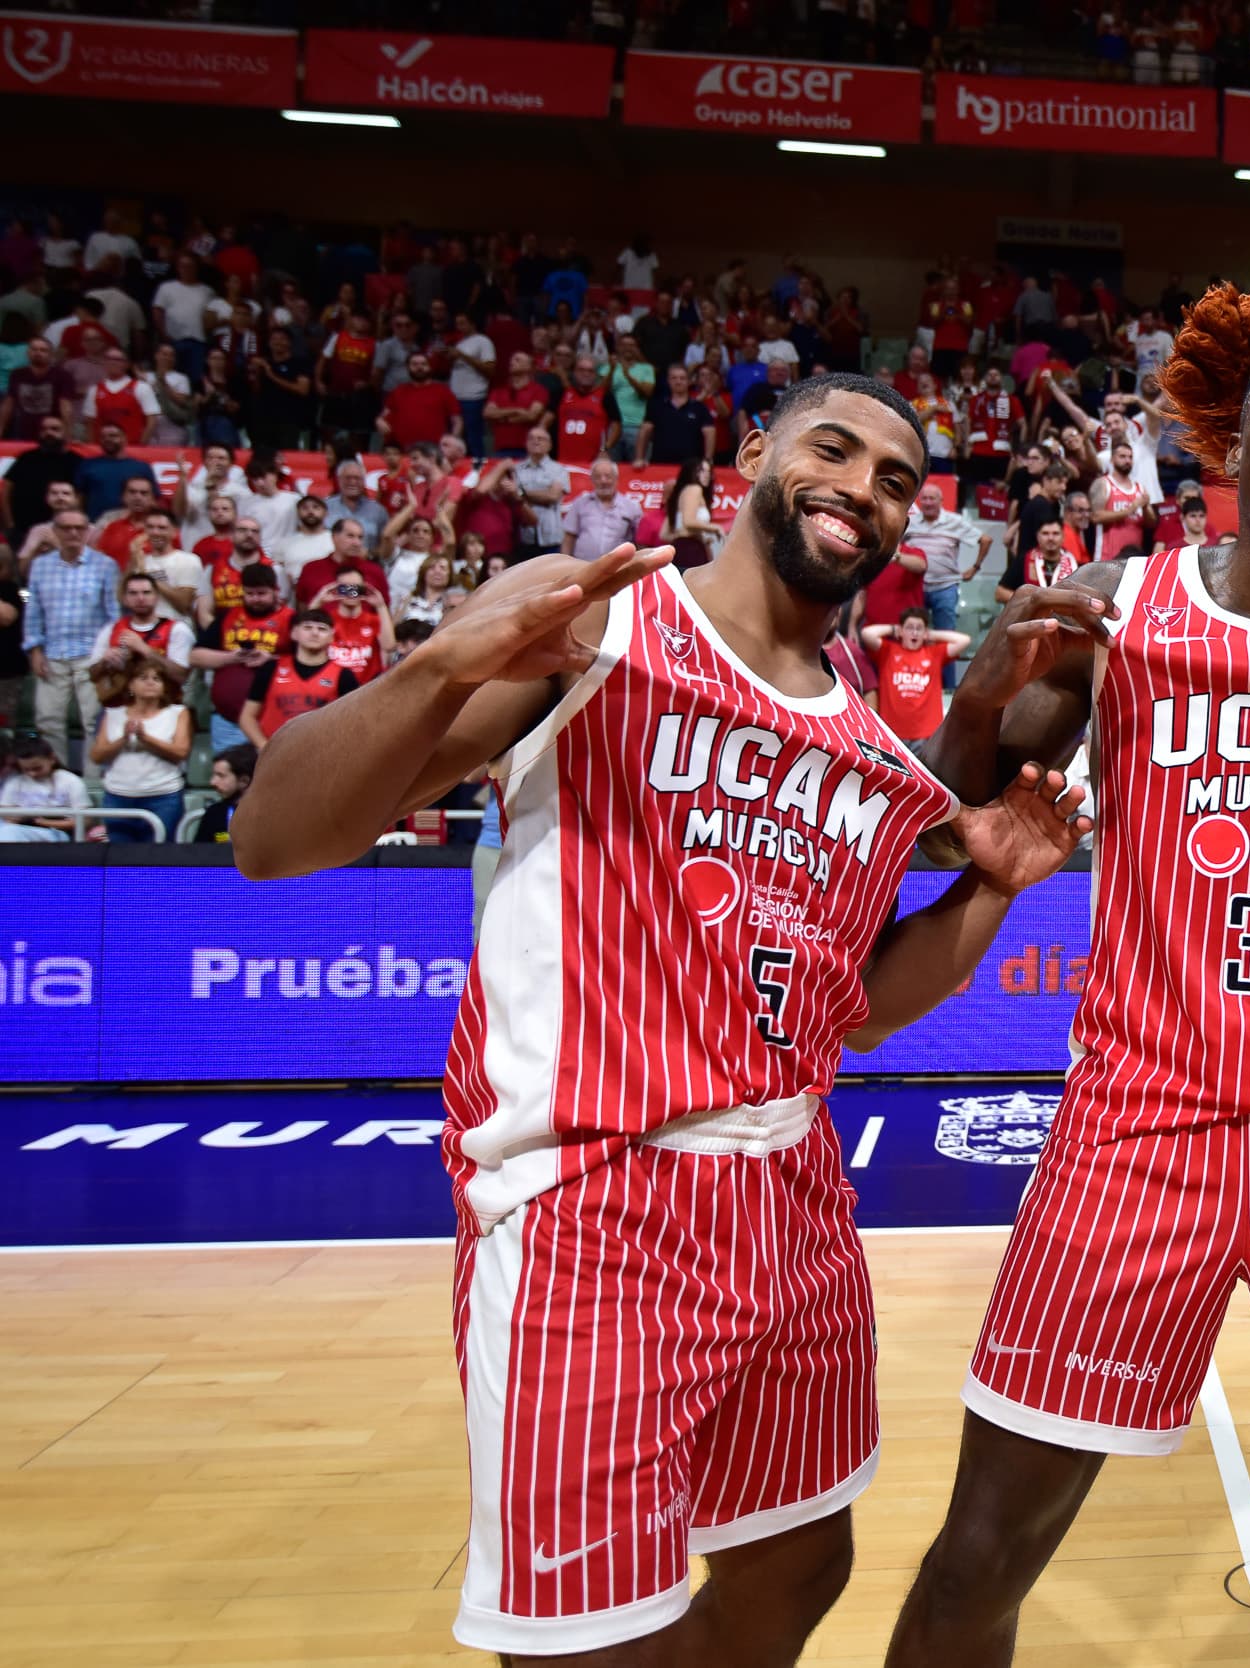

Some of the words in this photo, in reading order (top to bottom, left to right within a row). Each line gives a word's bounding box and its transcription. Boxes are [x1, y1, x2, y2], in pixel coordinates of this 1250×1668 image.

[112, 47, 270, 75] GASOLINERAS
[376, 73, 488, 105] Halcón
[491, 91, 545, 110] viajes
[727, 63, 854, 103] caser
[693, 103, 762, 127] Grupo
[767, 107, 853, 131] Helvetia
[648, 713, 891, 867] UCAM
[683, 807, 830, 893] MURCIA
[748, 909, 773, 930] DE
[751, 892, 809, 921] REGIÓN
[751, 945, 797, 1050] 5
[1064, 1351, 1161, 1383] INVERSUS
